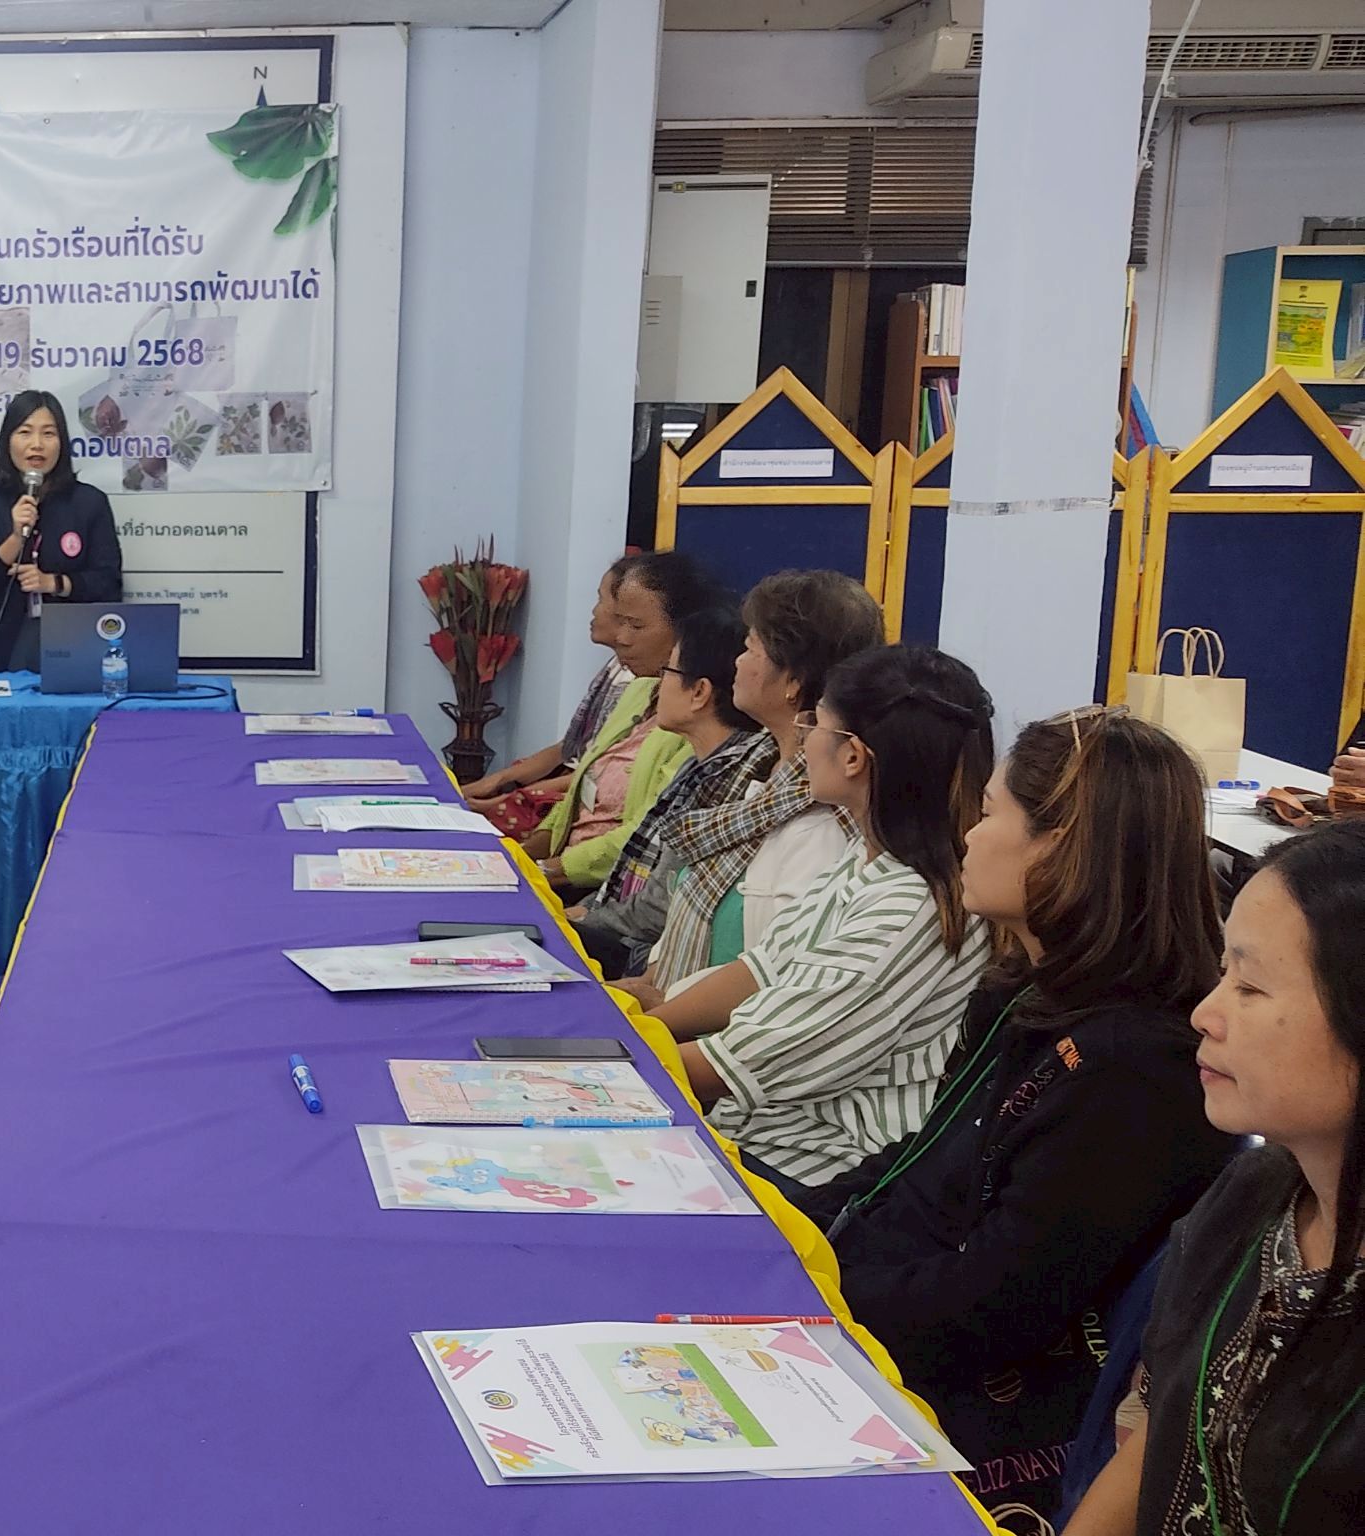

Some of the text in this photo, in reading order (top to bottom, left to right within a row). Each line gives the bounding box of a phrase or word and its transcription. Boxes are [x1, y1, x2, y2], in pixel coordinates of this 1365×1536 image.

[253, 66, 268, 80] N
[31, 338, 127, 368] ธันวาคม
[137, 339, 205, 366] 2568
